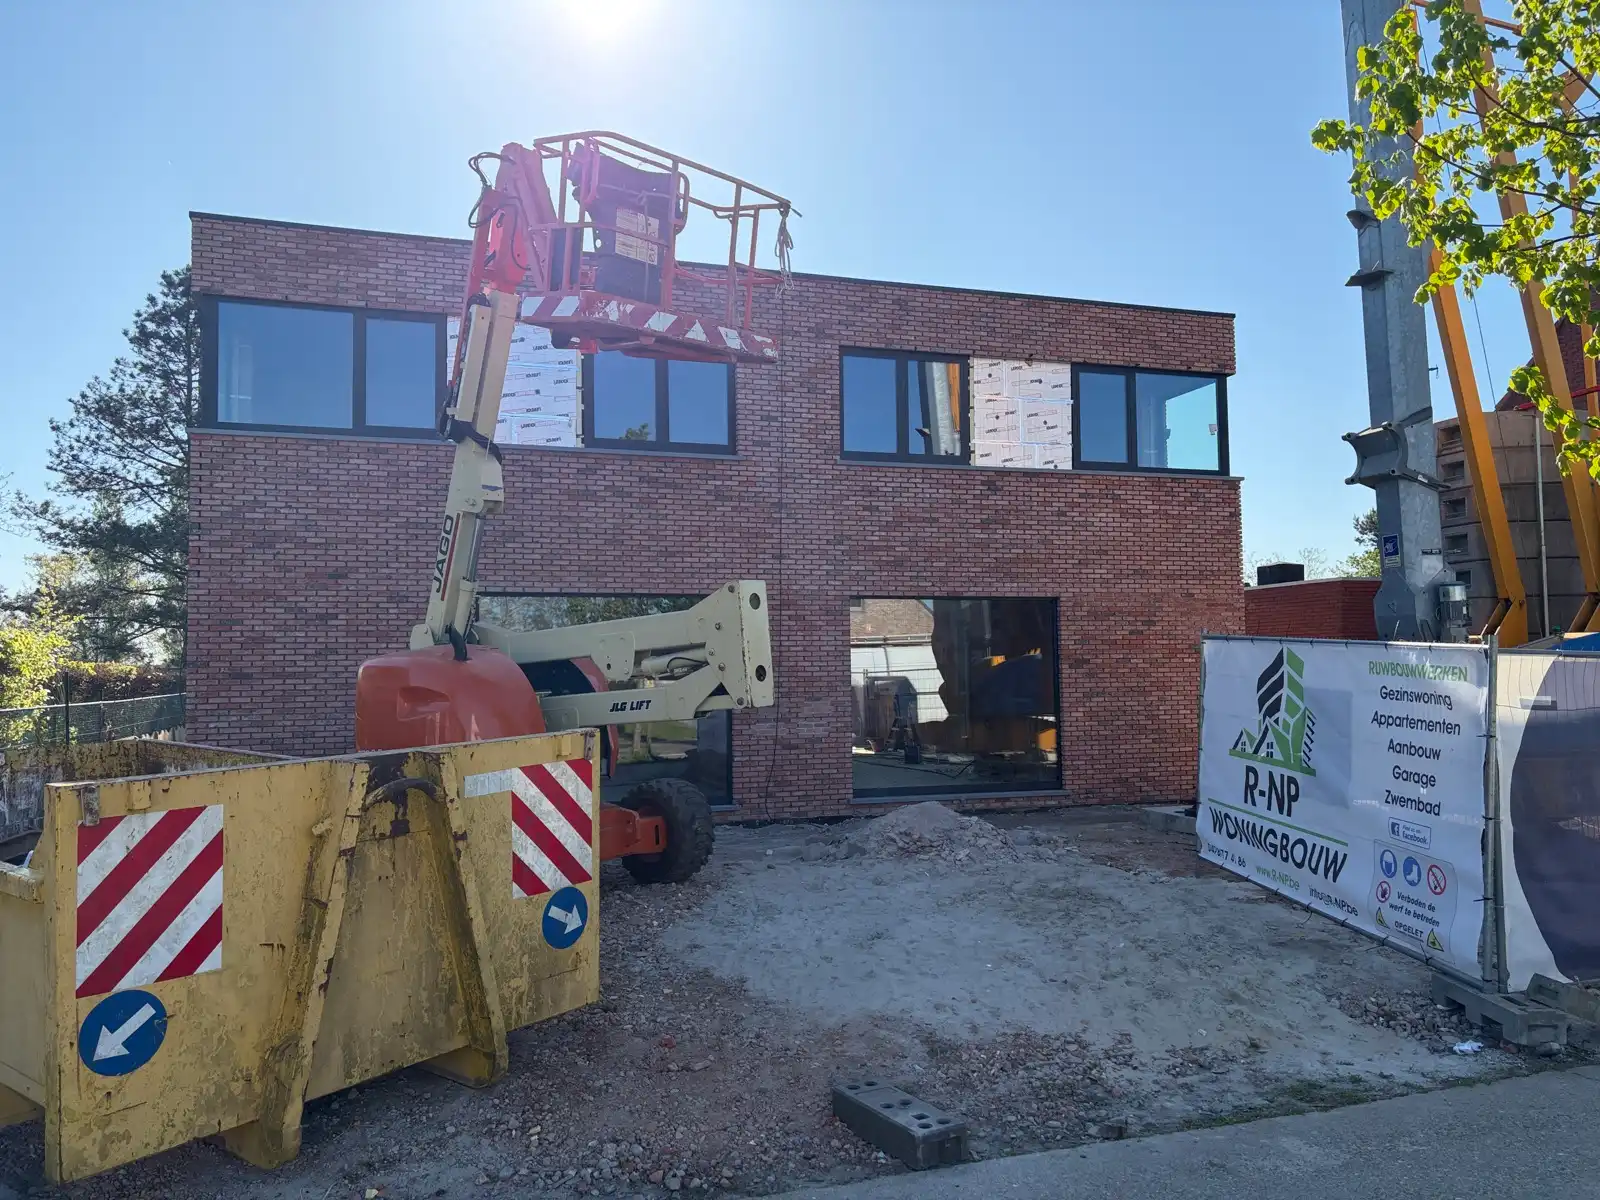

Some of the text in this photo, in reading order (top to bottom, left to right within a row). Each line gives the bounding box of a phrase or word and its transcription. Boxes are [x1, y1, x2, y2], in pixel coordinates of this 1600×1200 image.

[433, 514, 454, 593] JAGO
[1368, 660, 1468, 682] RUWBOUWWERKEN
[609, 700, 651, 712] JLG LIFT
[1379, 685, 1453, 710] Gezinswoning
[1371, 710, 1461, 735] Appartementen
[1387, 738, 1441, 760] Aanbouw
[1392, 765, 1436, 789] Garage
[1244, 764, 1300, 817] R-NP
[1384, 789, 1441, 817] Zwembad
[1209, 806, 1348, 883] WONINGBOUW
[1388, 902, 1440, 927] werf te betreden
[1397, 891, 1436, 913] Verboden de
[1394, 920, 1424, 938] OPGELET
